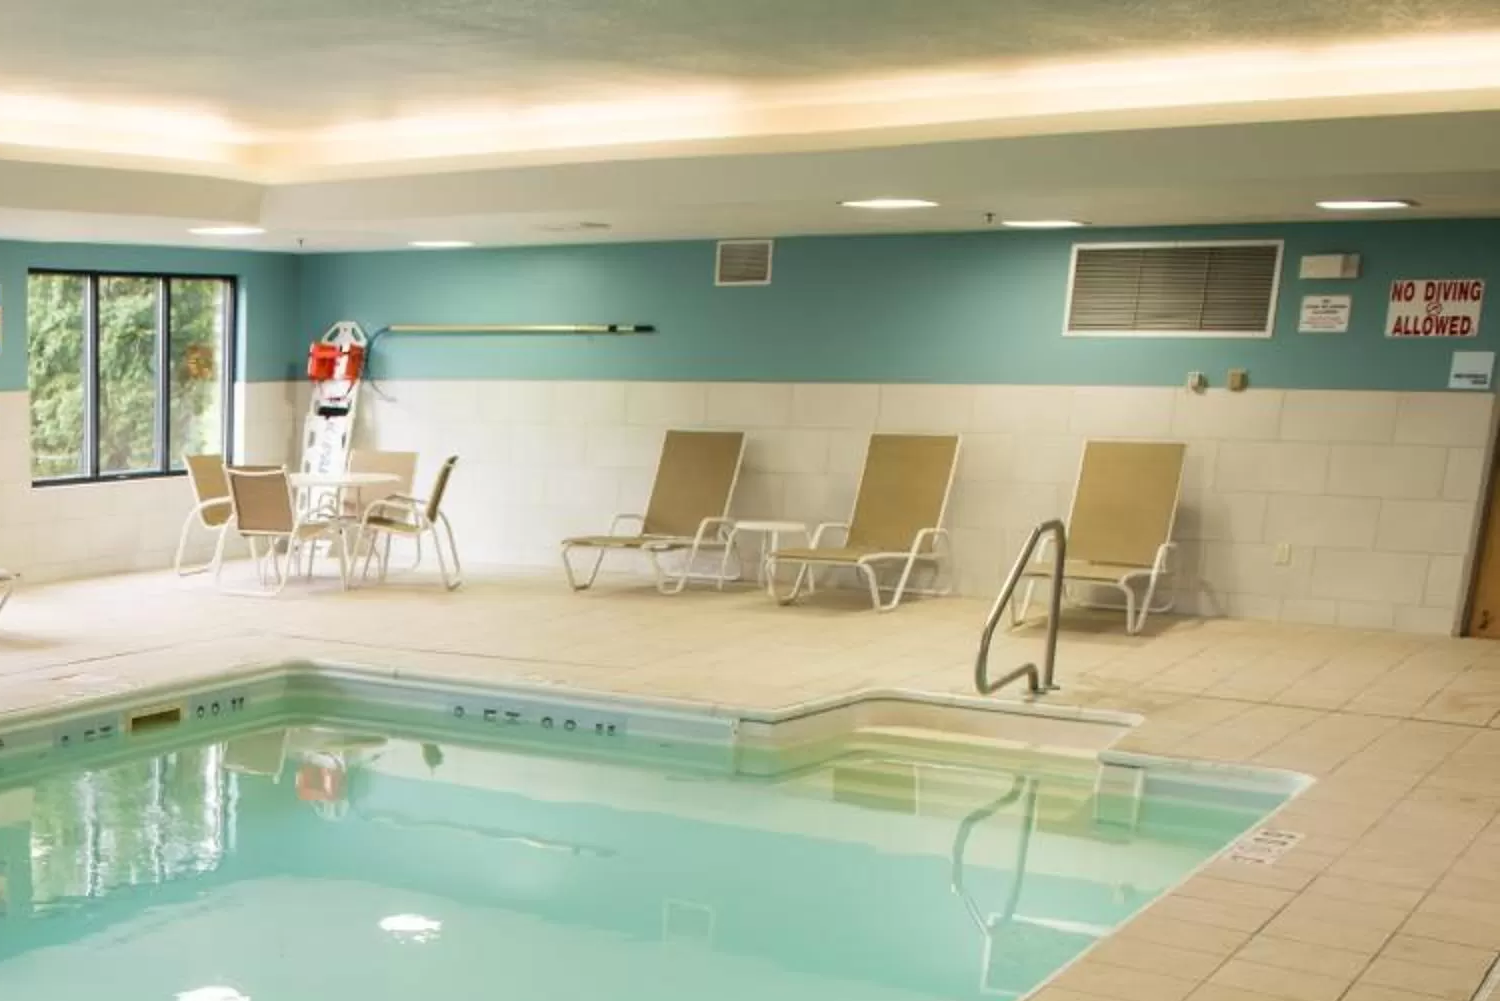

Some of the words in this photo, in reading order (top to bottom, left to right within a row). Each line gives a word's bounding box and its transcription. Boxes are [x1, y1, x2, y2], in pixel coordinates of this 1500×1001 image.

[1392, 282, 1415, 303] NO
[1424, 282, 1481, 303] DIVING
[1392, 316, 1471, 335] ALLOWED
